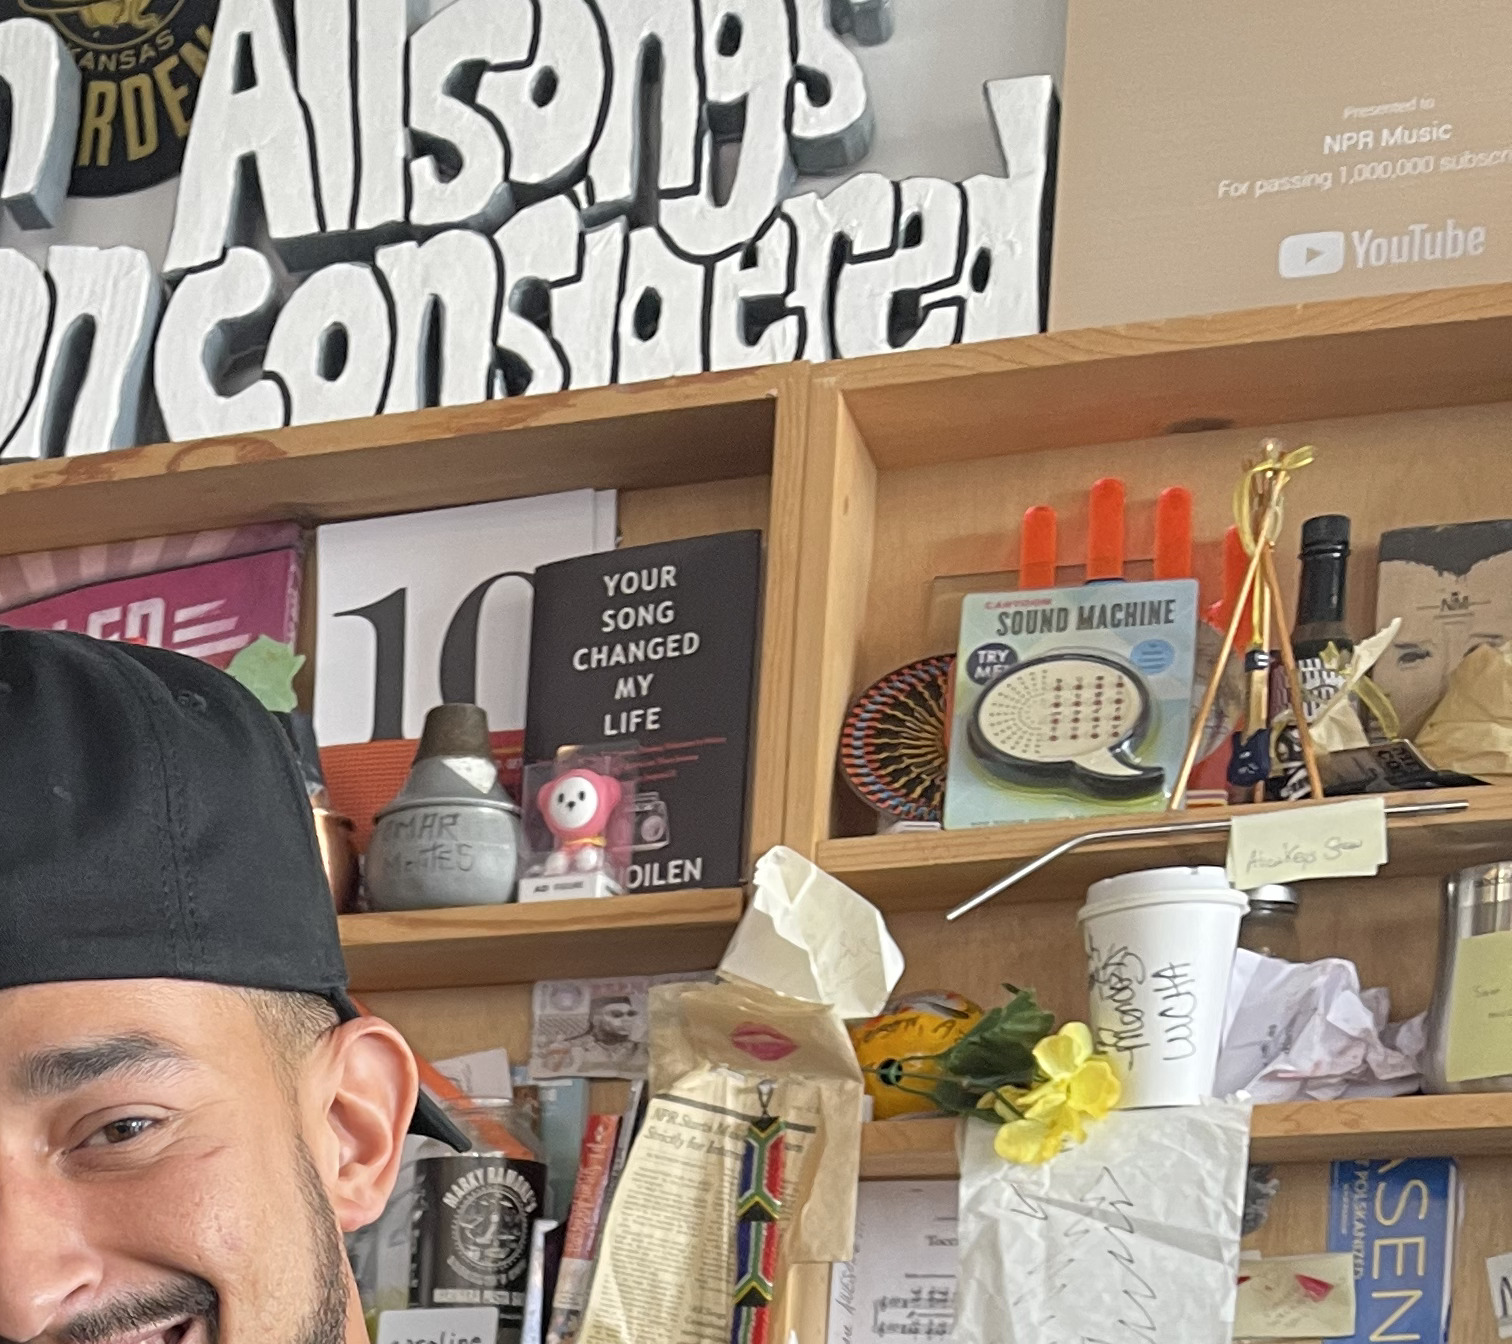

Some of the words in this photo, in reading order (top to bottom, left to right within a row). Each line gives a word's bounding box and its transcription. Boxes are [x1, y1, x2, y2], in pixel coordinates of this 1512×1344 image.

[1343, 97, 1417, 119] Presented
[1419, 97, 1435, 110] to
[1322, 130, 1374, 155] NPR
[1380, 120, 1453, 147] Music
[1217, 179, 1250, 199] For
[1254, 170, 1333, 198] passing
[1338, 155, 1435, 185] 1,000,000
[1350, 219, 1488, 269] YouTube
[602, 564, 677, 598] YOUR
[601, 600, 676, 633] SONG
[996, 606, 1070, 637] SOUND
[1076, 599, 1177, 631] MACHINE
[573, 631, 701, 671] CHANGED
[976, 649, 1009, 664] TRY
[614, 674, 655, 703] MY
[603, 704, 662, 736] LIFE
[619, 857, 703, 888] OILEN
